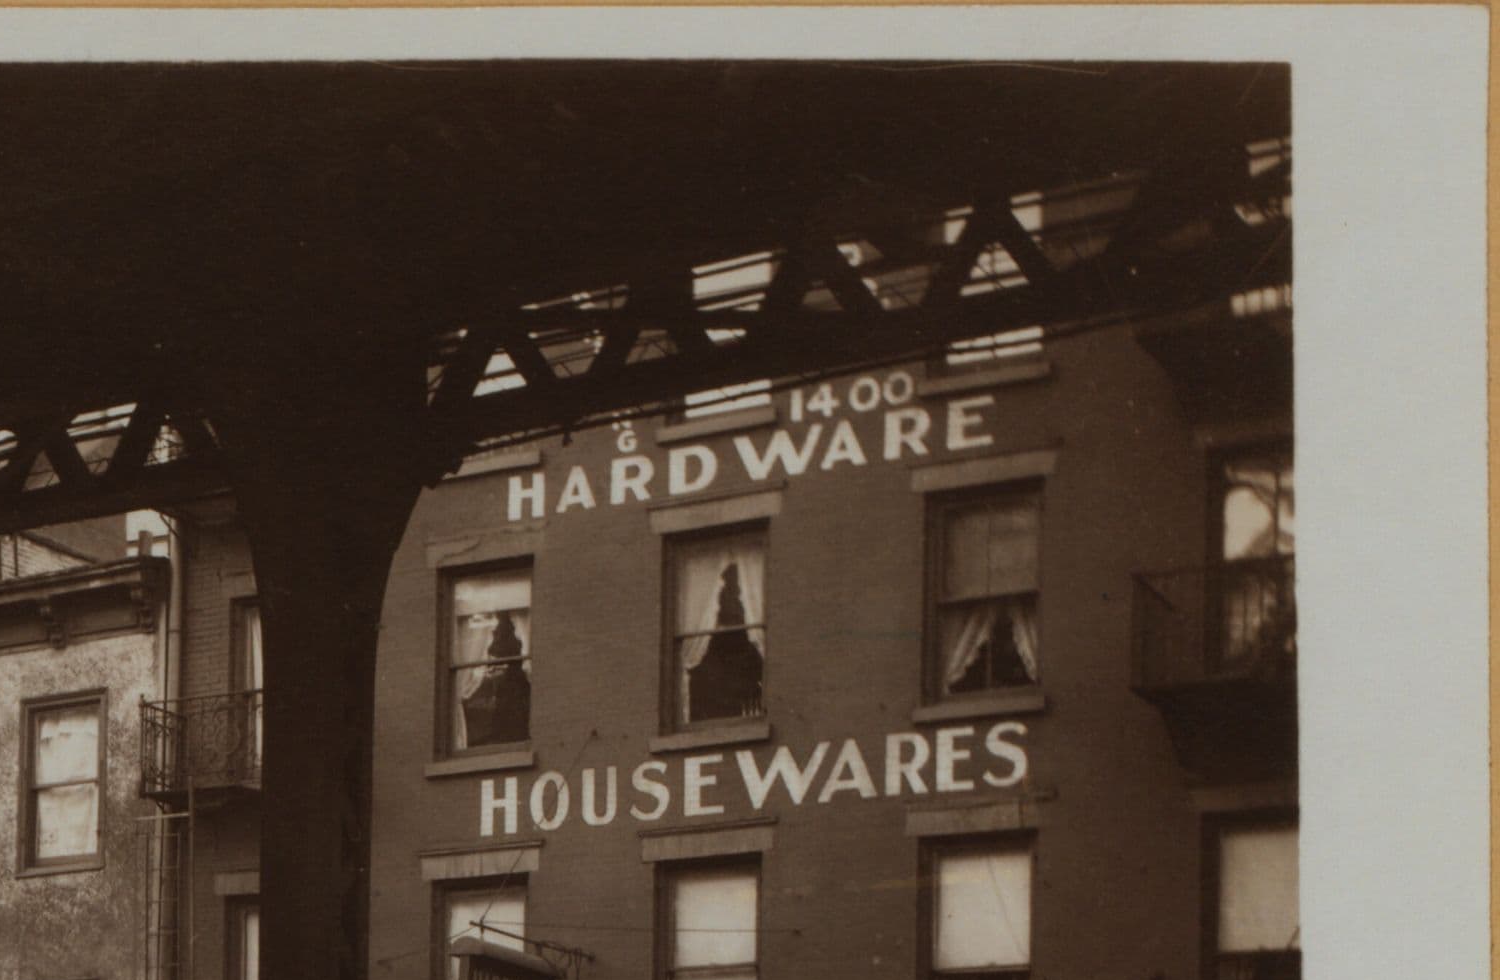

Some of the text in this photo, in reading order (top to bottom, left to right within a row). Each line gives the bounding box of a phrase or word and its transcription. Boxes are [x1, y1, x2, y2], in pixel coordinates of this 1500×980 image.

[789, 370, 915, 423] 1400
[506, 394, 995, 521] HARDWARE
[478, 720, 1029, 837] HOUSEWARES
